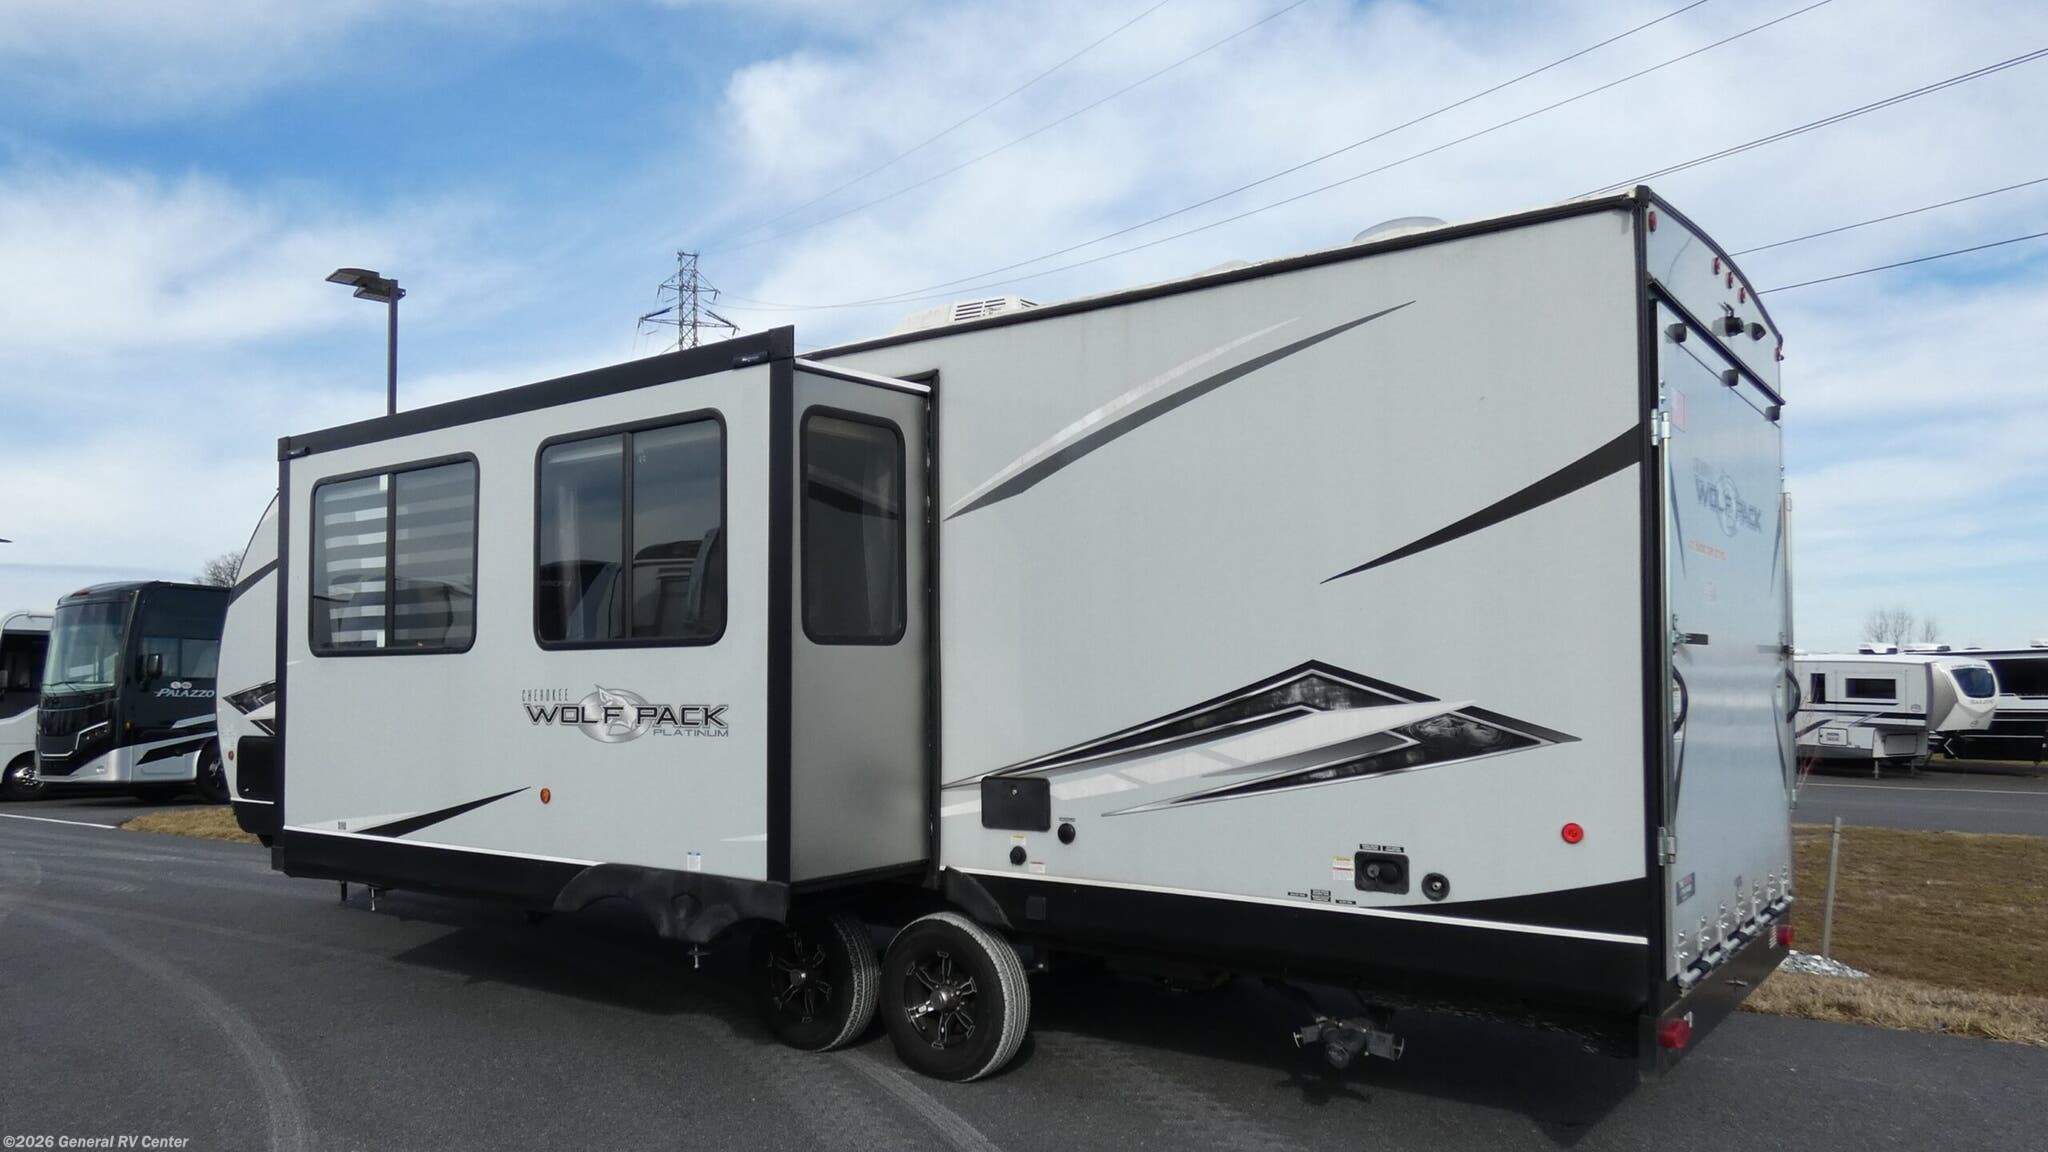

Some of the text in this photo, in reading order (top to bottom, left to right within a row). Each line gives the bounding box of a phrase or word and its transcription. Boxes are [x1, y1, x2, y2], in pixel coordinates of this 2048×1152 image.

[154, 688, 215, 698] PALAZZO
[521, 687, 569, 701] CHEROKEE
[523, 703, 729, 728] WOLF PACK
[652, 728, 729, 737] PLATINUM
